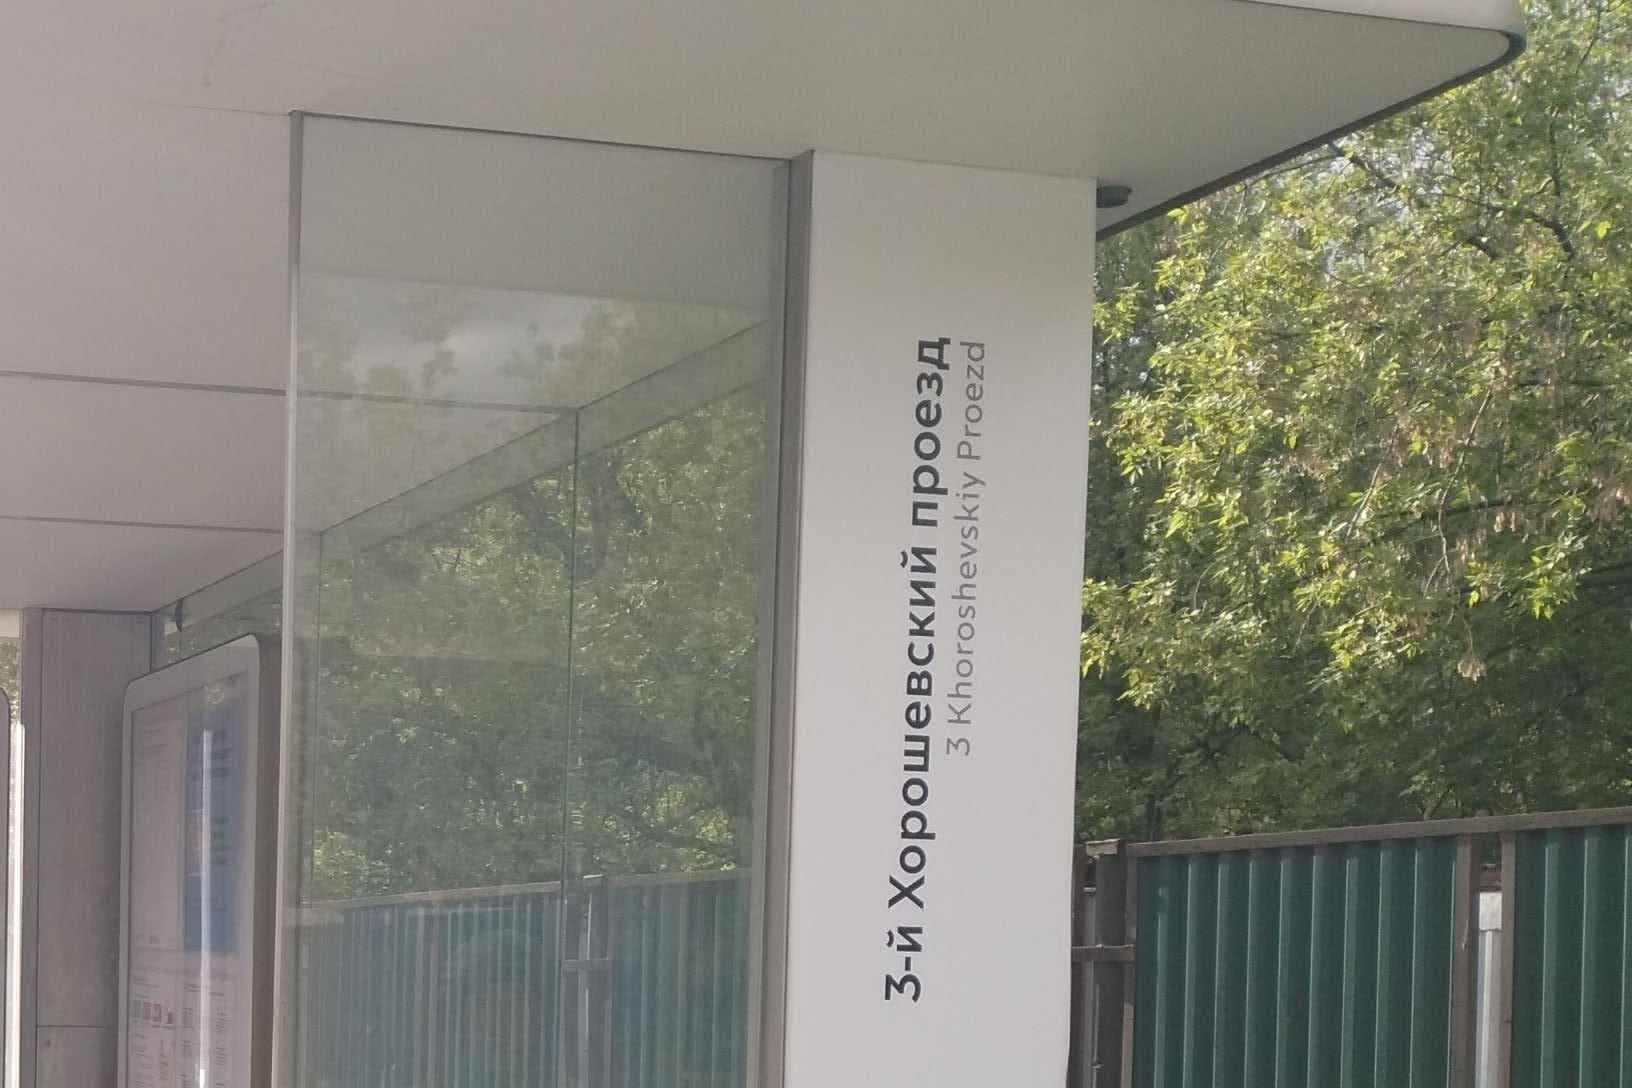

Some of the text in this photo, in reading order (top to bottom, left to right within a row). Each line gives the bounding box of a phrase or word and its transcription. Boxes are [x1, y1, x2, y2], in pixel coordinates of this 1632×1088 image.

[884, 337, 951, 1003] 3-й Хорошевский проезд
[946, 341, 986, 756] 3 Khoroshevskiy Proezd
